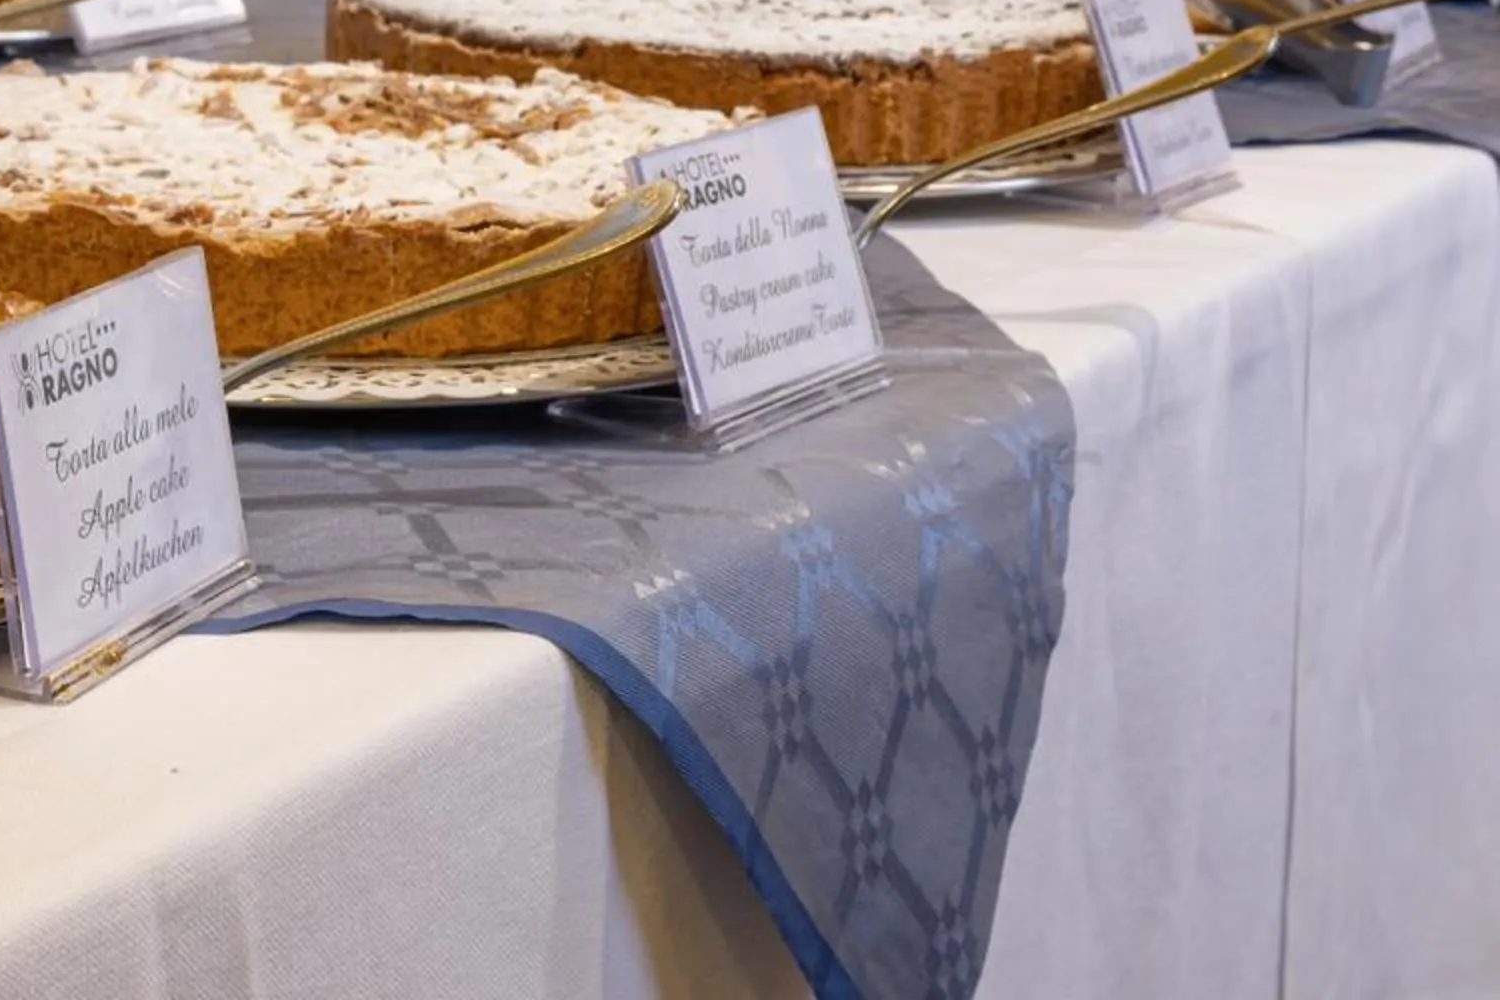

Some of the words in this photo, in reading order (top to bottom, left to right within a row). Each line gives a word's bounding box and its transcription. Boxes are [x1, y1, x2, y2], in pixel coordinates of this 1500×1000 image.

[673, 152, 726, 182] HOTEL
[682, 173, 746, 211] RAGNO
[679, 234, 732, 267] Torta
[735, 216, 771, 254] della
[771, 206, 828, 240] Nonna
[700, 283, 757, 319] Pastry
[760, 273, 802, 300] cream
[804, 248, 836, 286] cake
[36, 322, 98, 371] HOTEL
[42, 347, 118, 406] RAGNO
[46, 435, 108, 483] Torta
[113, 404, 151, 455] alla
[156, 381, 198, 434] mele
[78, 474, 145, 542] Apple
[149, 454, 190, 503] cake
[78, 519, 204, 609] Apfelkuchen
